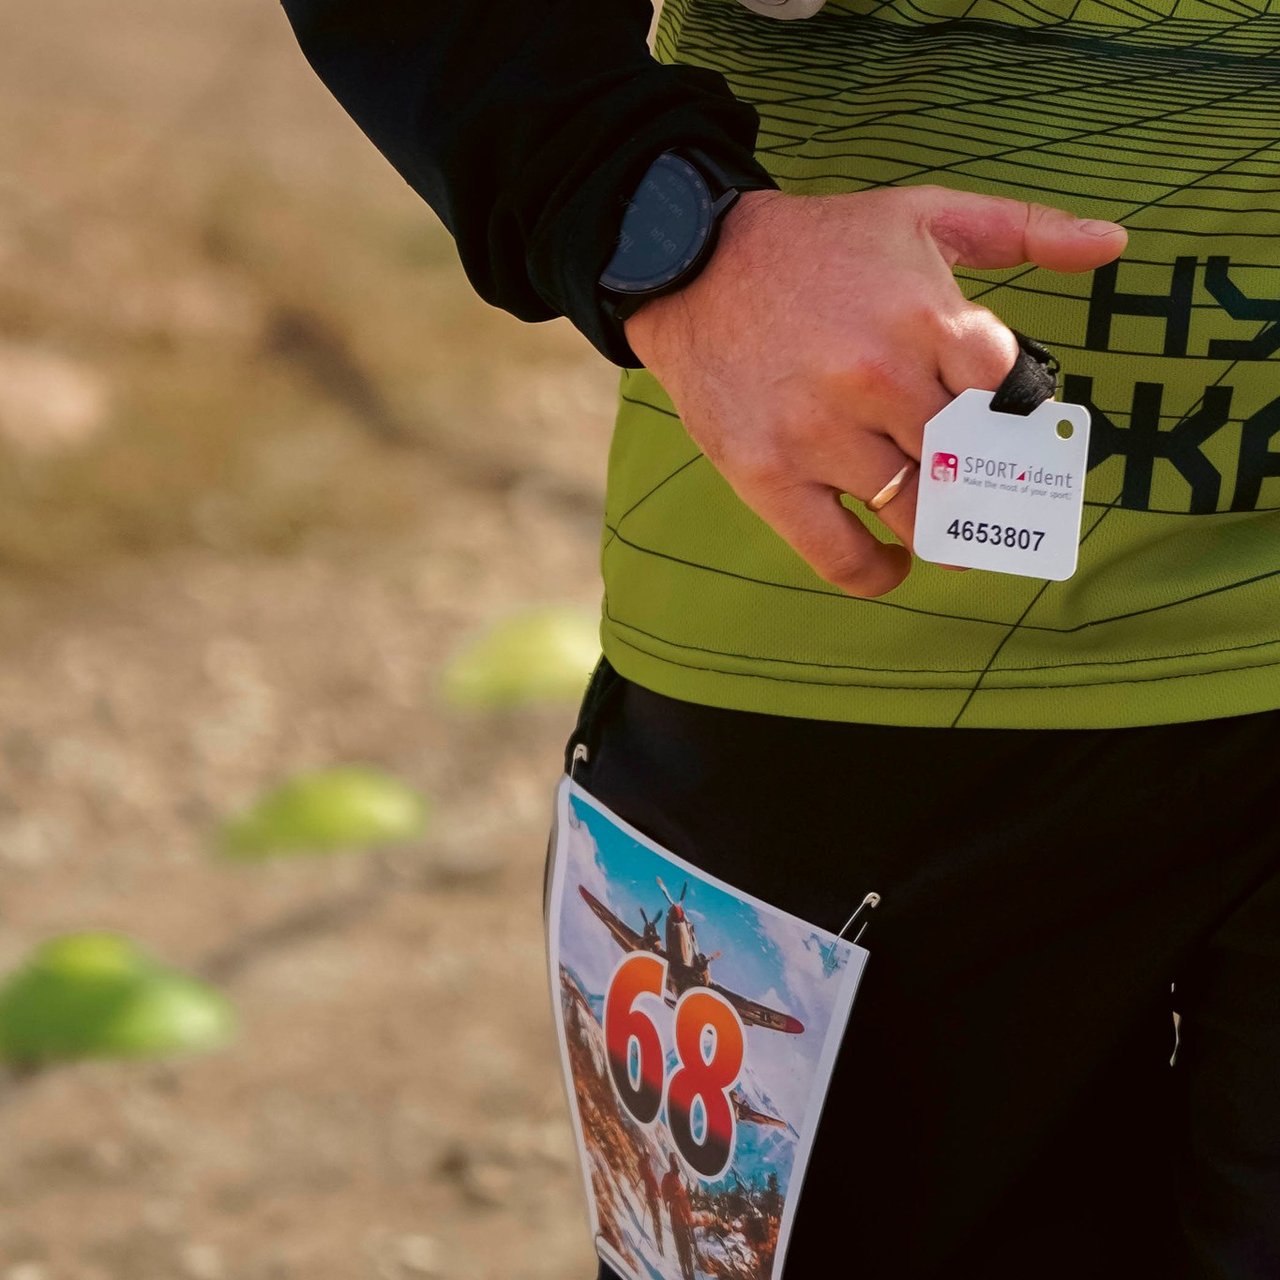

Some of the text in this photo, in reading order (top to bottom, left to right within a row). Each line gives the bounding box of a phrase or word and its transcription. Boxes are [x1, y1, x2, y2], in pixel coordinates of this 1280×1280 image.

[985, 480, 997, 489] the
[1021, 485, 1029, 493] of
[1031, 488, 1048, 497] your
[947, 519, 1046, 552] 4653807
[604, 950, 748, 1182] 68
